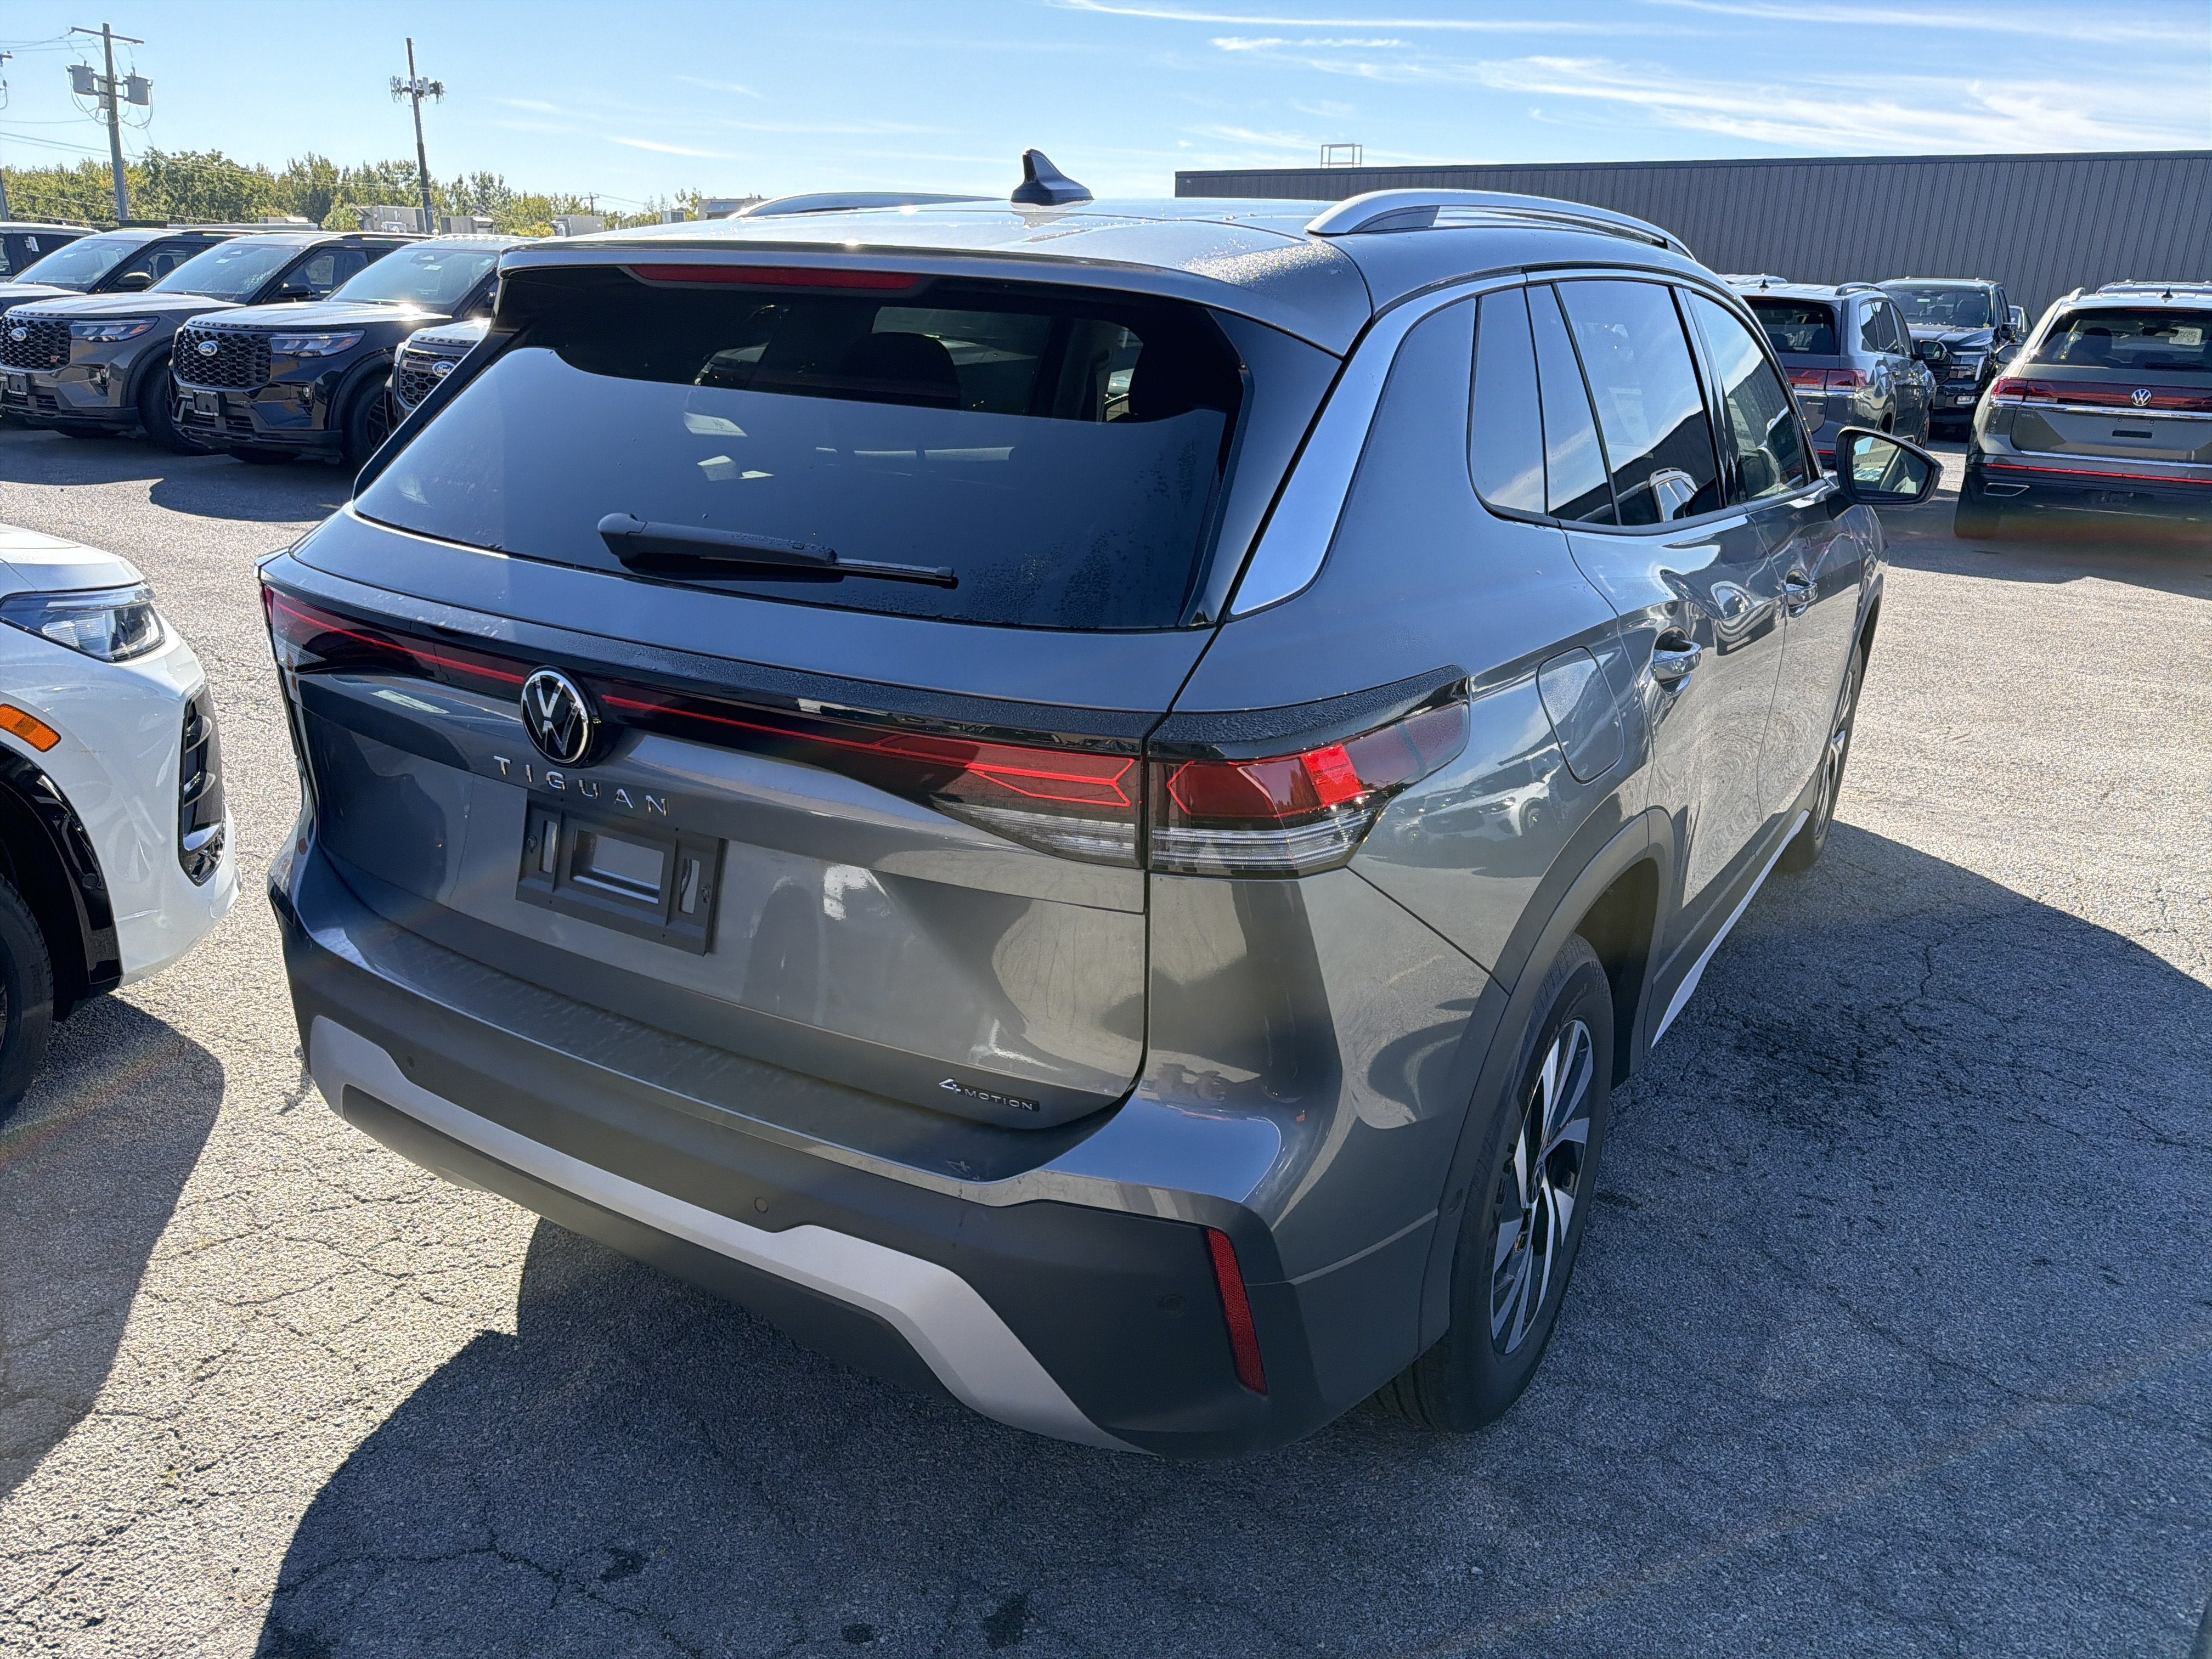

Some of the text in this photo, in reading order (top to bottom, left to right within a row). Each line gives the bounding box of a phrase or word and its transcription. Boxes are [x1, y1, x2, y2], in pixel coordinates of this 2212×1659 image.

[2131, 388, 2152, 406] VW
[522, 668, 590, 763] VW
[493, 755, 670, 816] TIGUAN
[938, 1077, 1034, 1111] 4MOTION
